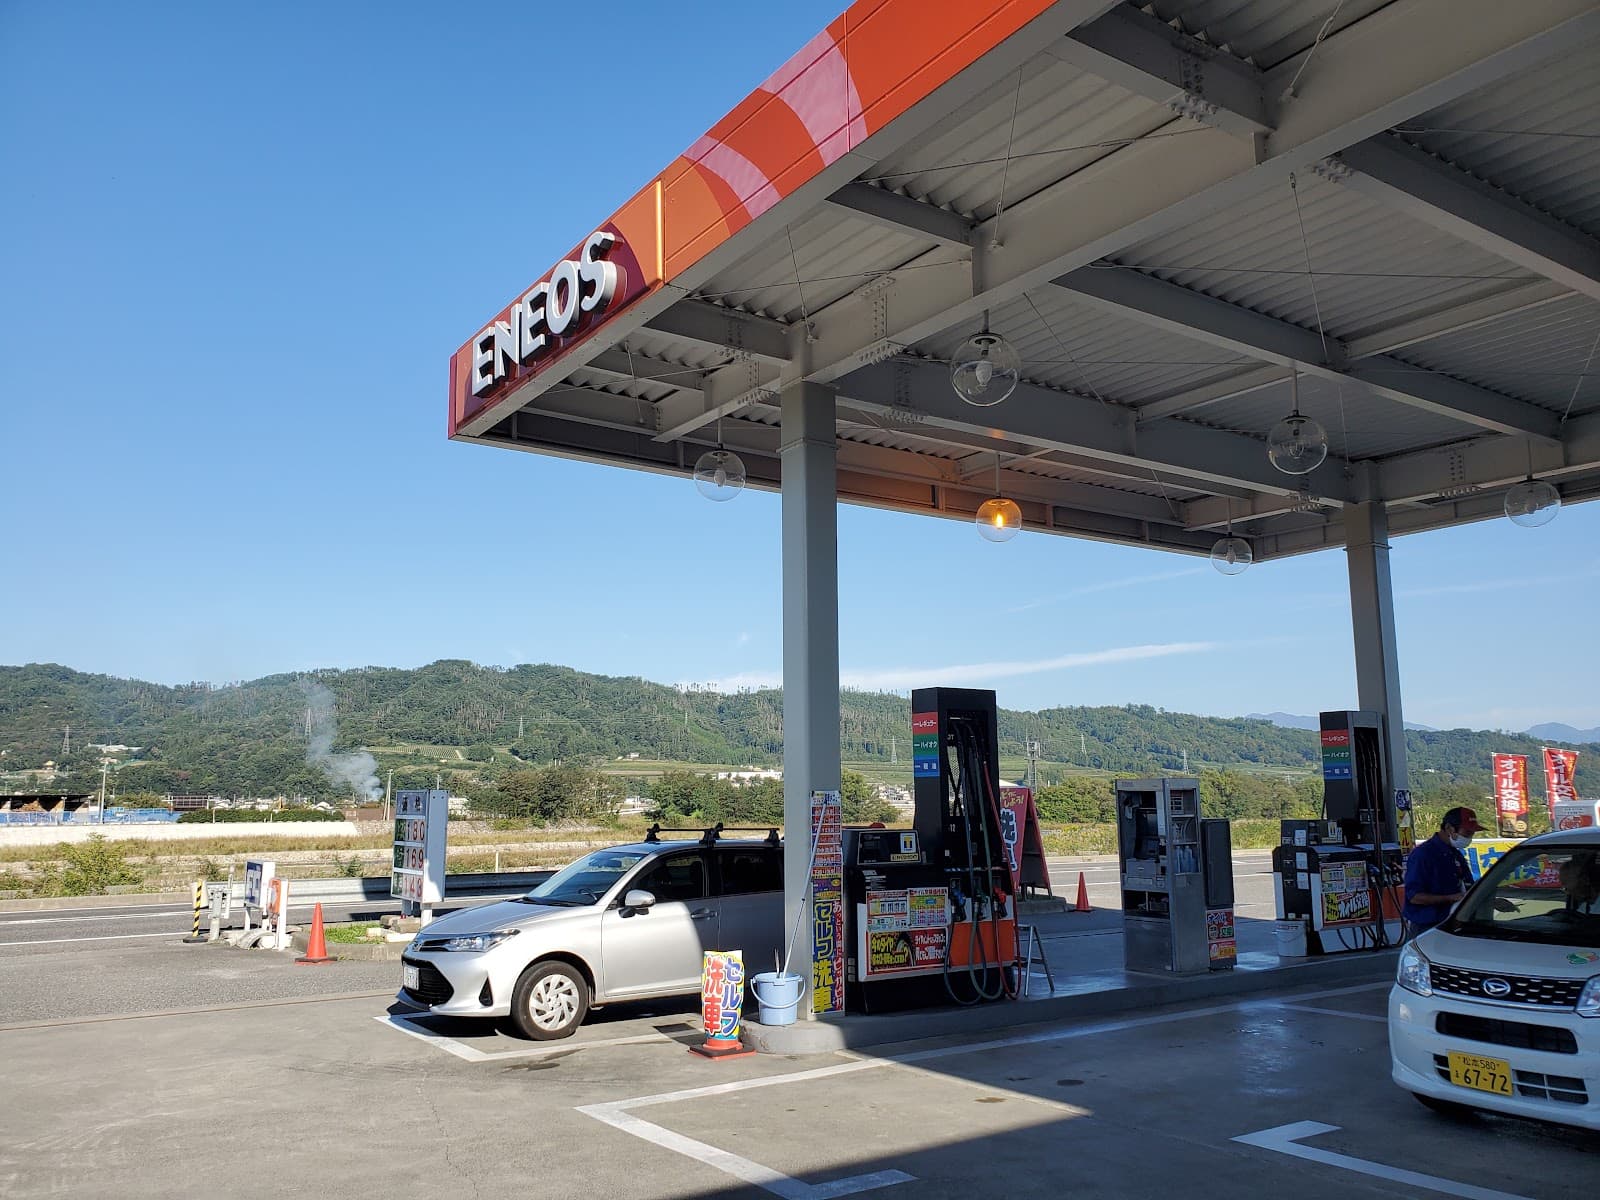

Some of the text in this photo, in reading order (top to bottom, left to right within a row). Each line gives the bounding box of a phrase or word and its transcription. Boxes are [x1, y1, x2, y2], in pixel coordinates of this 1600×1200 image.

[472, 231, 618, 397] ENEOS
[920, 741, 938, 749] ハイオク
[1500, 758, 1521, 812] オイル交換
[407, 821, 425, 841] 180
[406, 848, 424, 869] 169
[703, 956, 724, 1036] 洗車
[721, 956, 742, 1036] セルフ
[1463, 1068, 1509, 1092] 67-72
